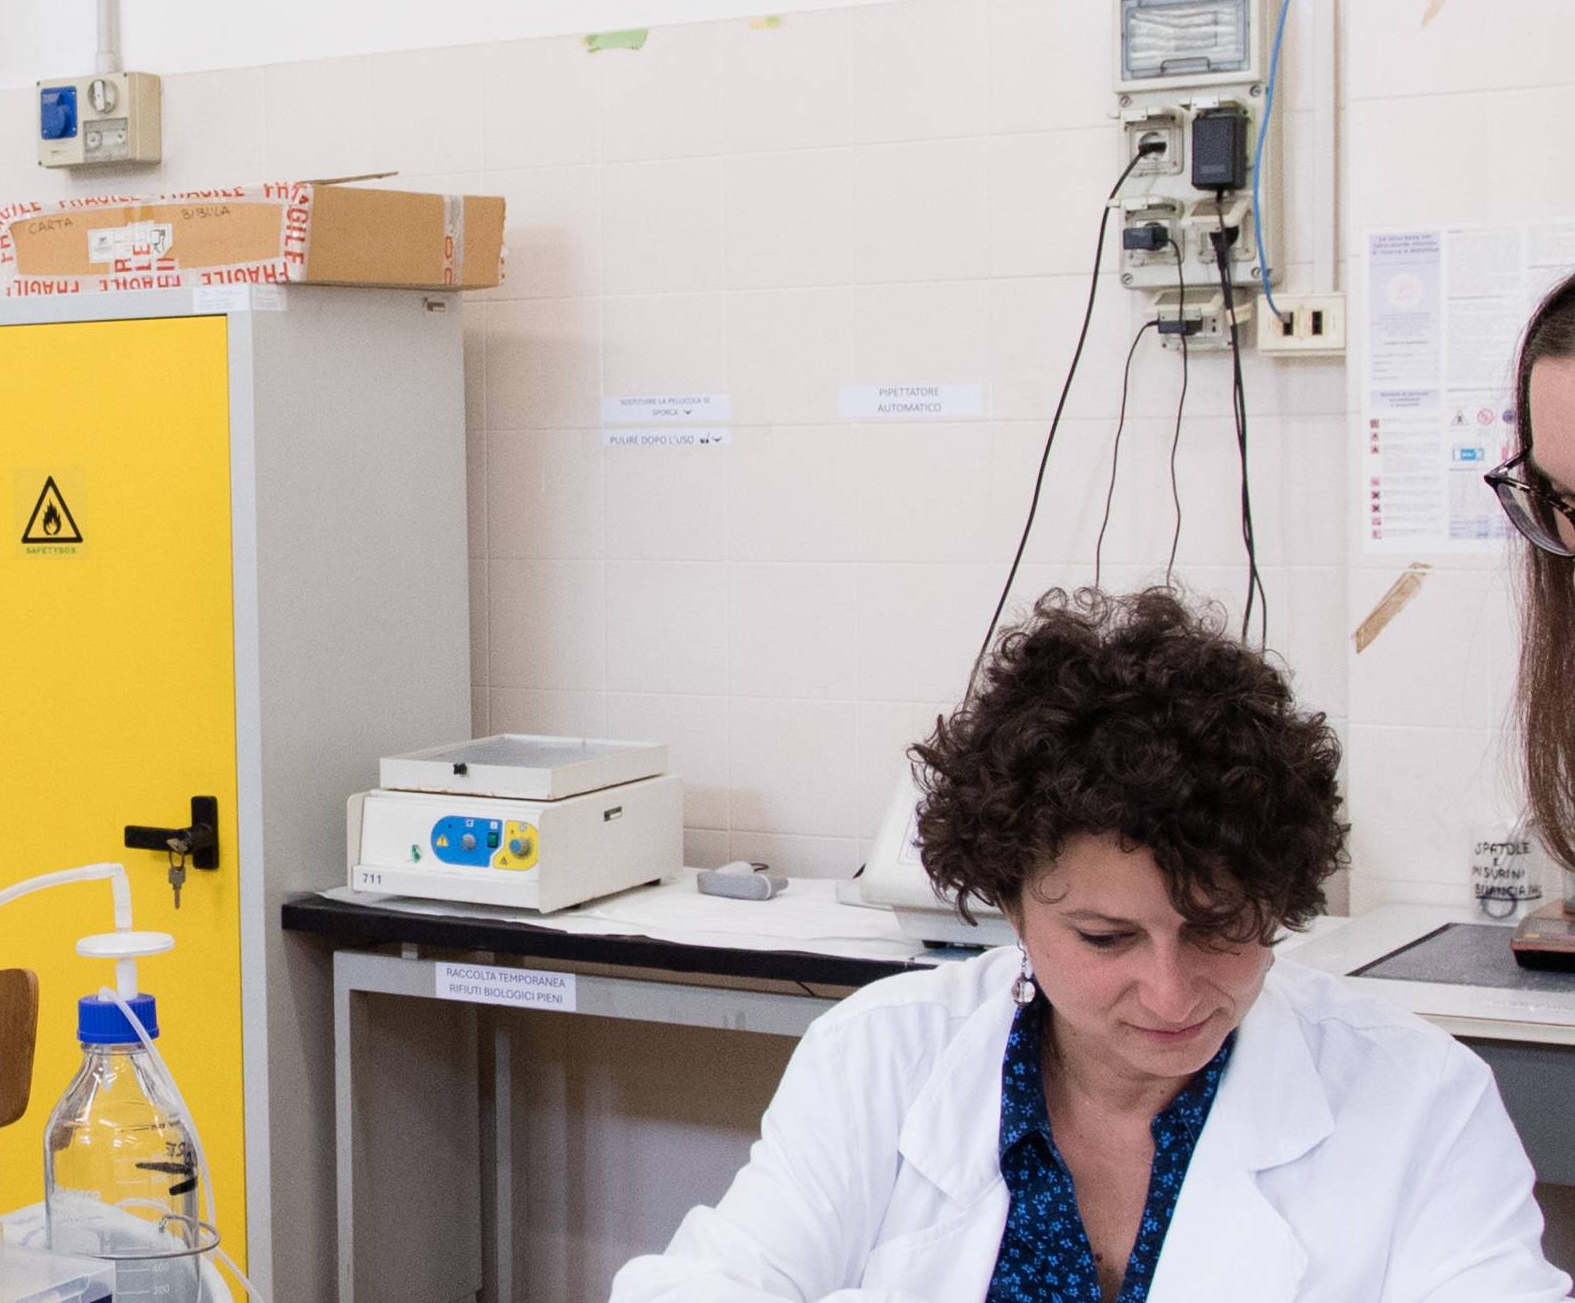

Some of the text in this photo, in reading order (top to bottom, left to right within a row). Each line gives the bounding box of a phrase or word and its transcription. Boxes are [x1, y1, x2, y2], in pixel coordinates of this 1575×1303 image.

[28, 218, 74, 235] CARTA
[201, 262, 290, 287] FRAGILE
[878, 386, 940, 397] PIPETTATORE
[877, 402, 942, 413] AUTOMATICO
[609, 434, 695, 445] PULIRE DOPO L'USO
[25, 546, 77, 555] SAFETYBOX
[363, 872, 382, 886] 711
[446, 967, 566, 988] RACCOLTA TEMPORANEA
[449, 983, 563, 1004] RIFIUTI BIOLOGICI PIENI
